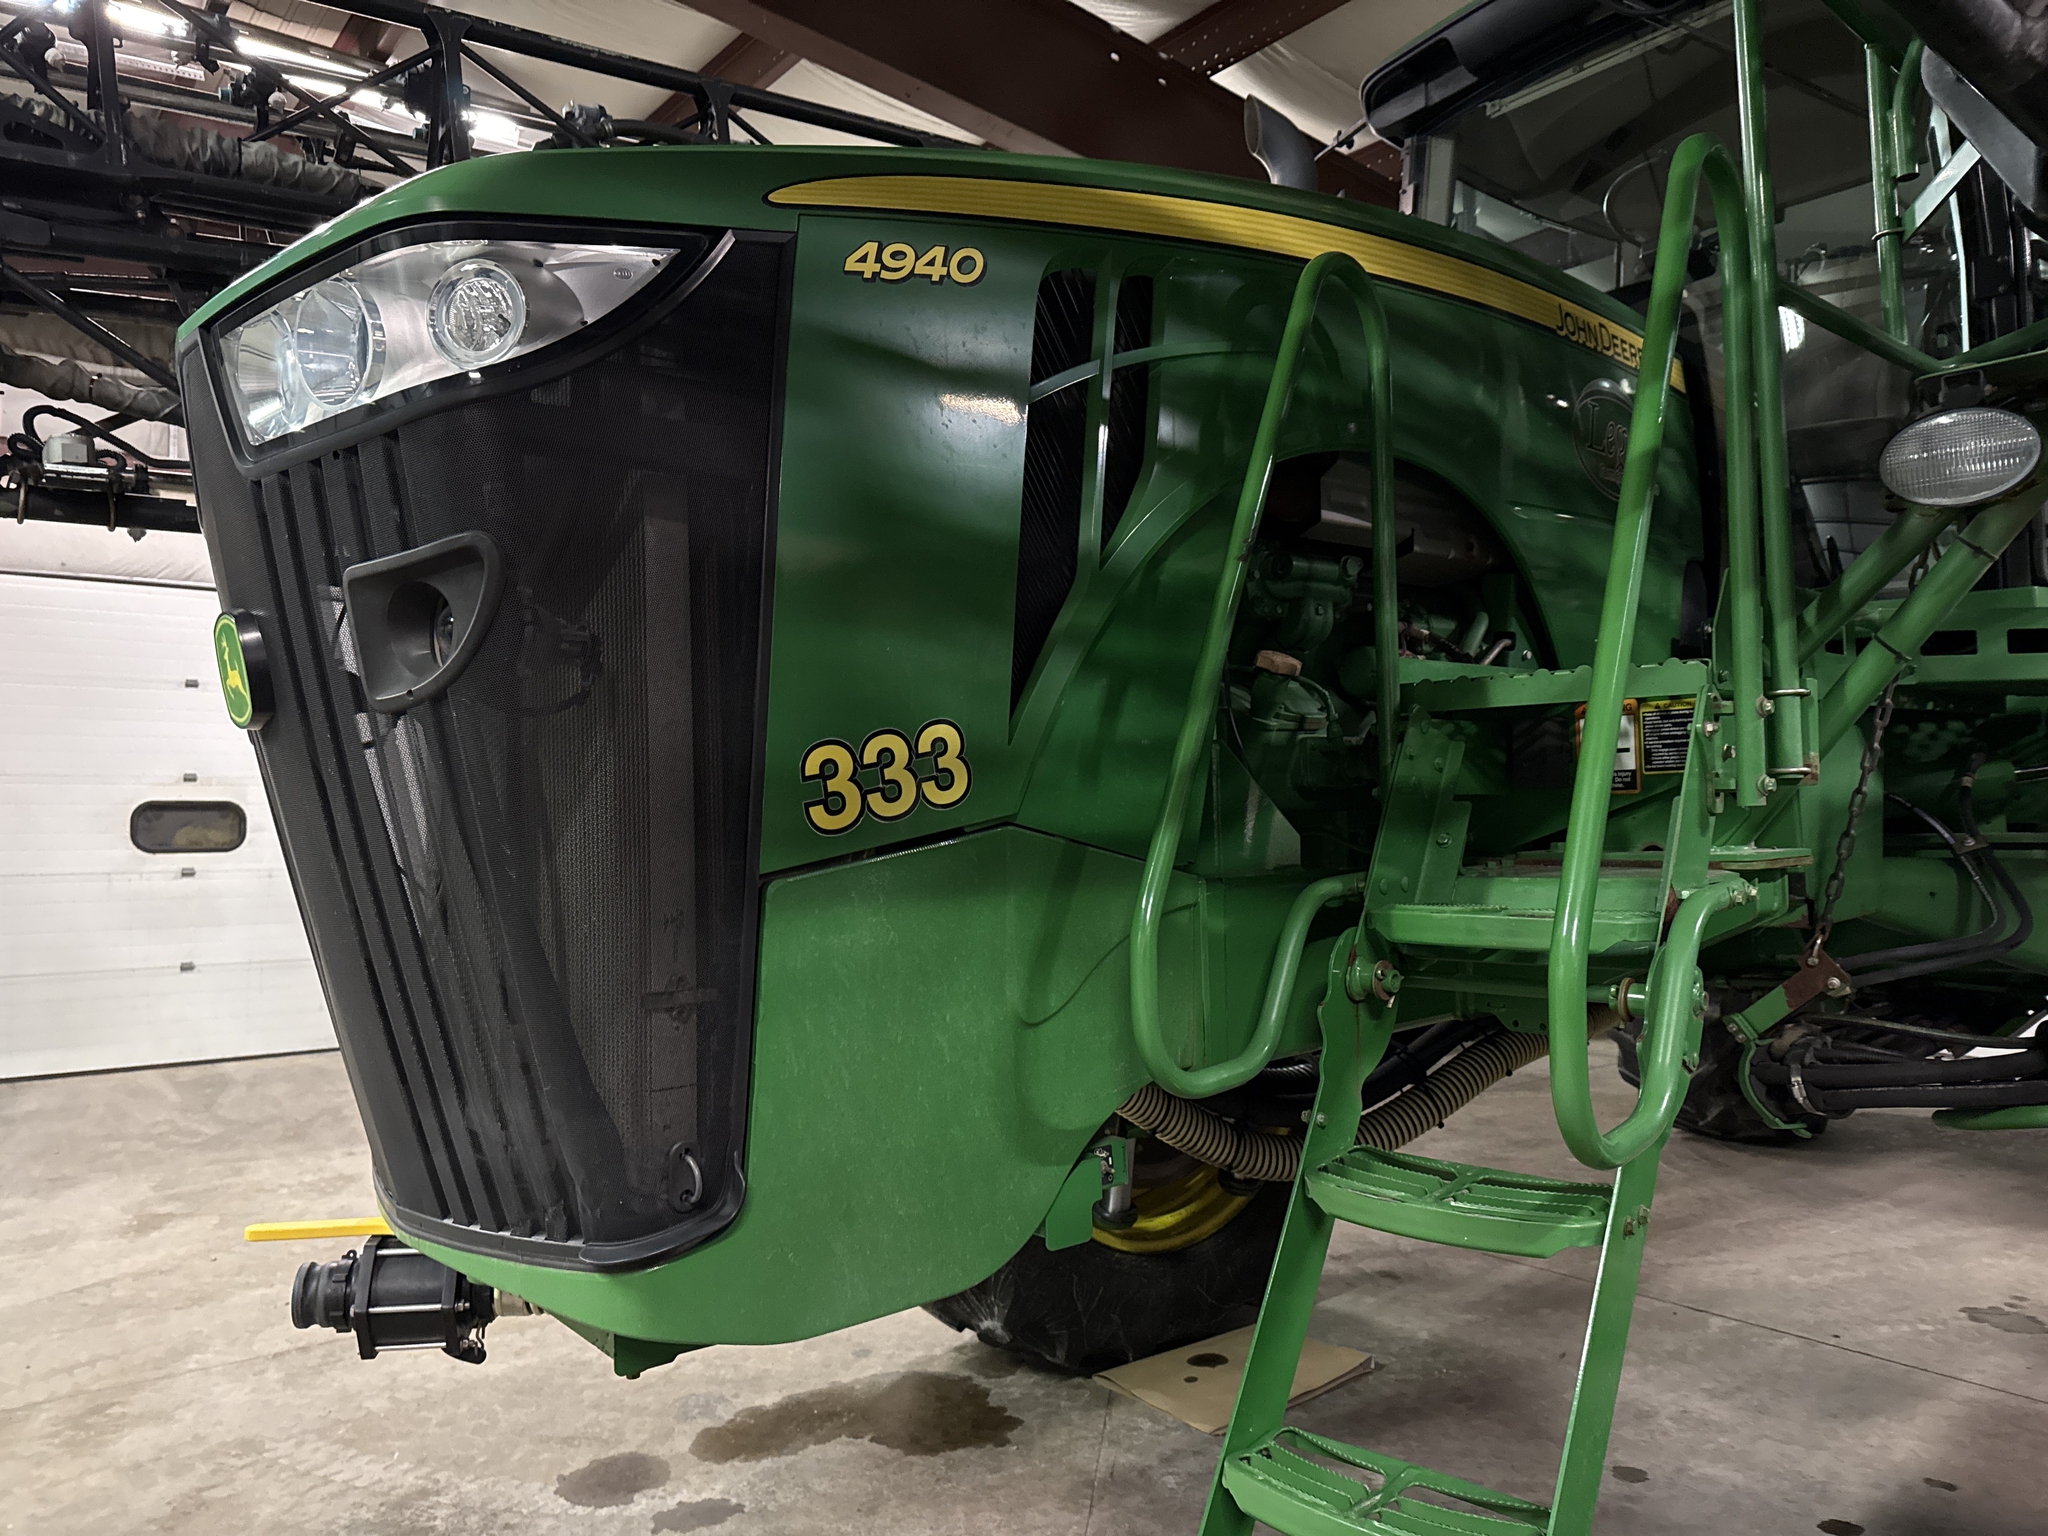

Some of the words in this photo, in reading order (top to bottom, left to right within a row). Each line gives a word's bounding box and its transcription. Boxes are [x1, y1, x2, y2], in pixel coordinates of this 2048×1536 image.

[844, 240, 987, 287] 4940
[1556, 303, 1600, 352] JOHN
[1586, 401, 1628, 470] Leg
[1663, 701, 1692, 709] CAUTION
[800, 718, 972, 837] 333
